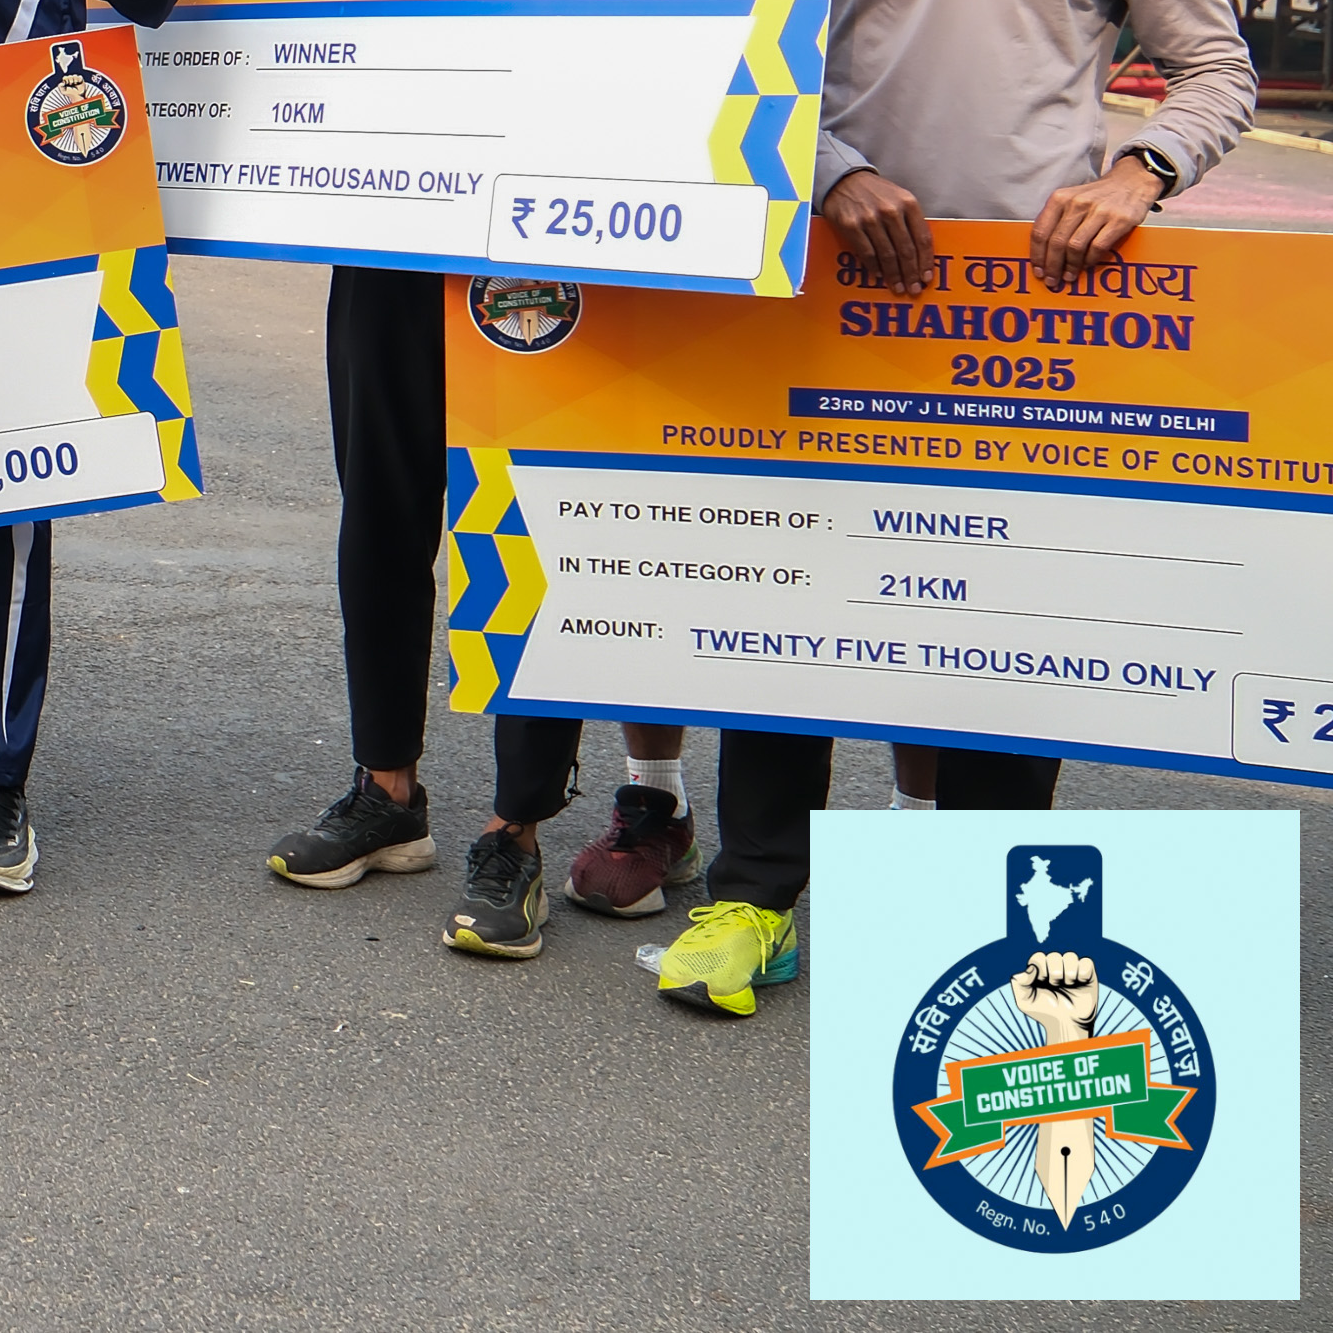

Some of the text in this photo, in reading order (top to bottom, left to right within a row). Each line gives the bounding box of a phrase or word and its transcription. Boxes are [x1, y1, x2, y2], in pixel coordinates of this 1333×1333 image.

[145, 44, 356, 66] THE ORDER OF WINNER
[209, 103, 324, 123] OF: 10KM
[156, 162, 483, 194] TWENTY FIVE THOUSAND ONLY
[546, 199, 681, 244] 25,000
[963, 256, 1032, 294] का
[840, 301, 1194, 350] SHAHOTHON
[952, 354, 1075, 391] 2025
[819, 397, 864, 411] 23RD
[919, 402, 929, 414] J
[938, 402, 947, 415] L
[954, 403, 1015, 419] NEHRU
[1023, 407, 1102, 424] STADIUM
[1111, 412, 1152, 427] NEW
[1161, 415, 1214, 431] DELHI
[663, 425, 1159, 470] PROUDLY PRESENTED BY VOICE OF
[560, 502, 1009, 540] PAY TO THE ORDER OF WINNER
[560, 557, 966, 601] IN THE CATEGORY OF: 21KM
[560, 619, 1216, 691] AMOUNT: TWENTY FIVE THOUSAND ONLY
